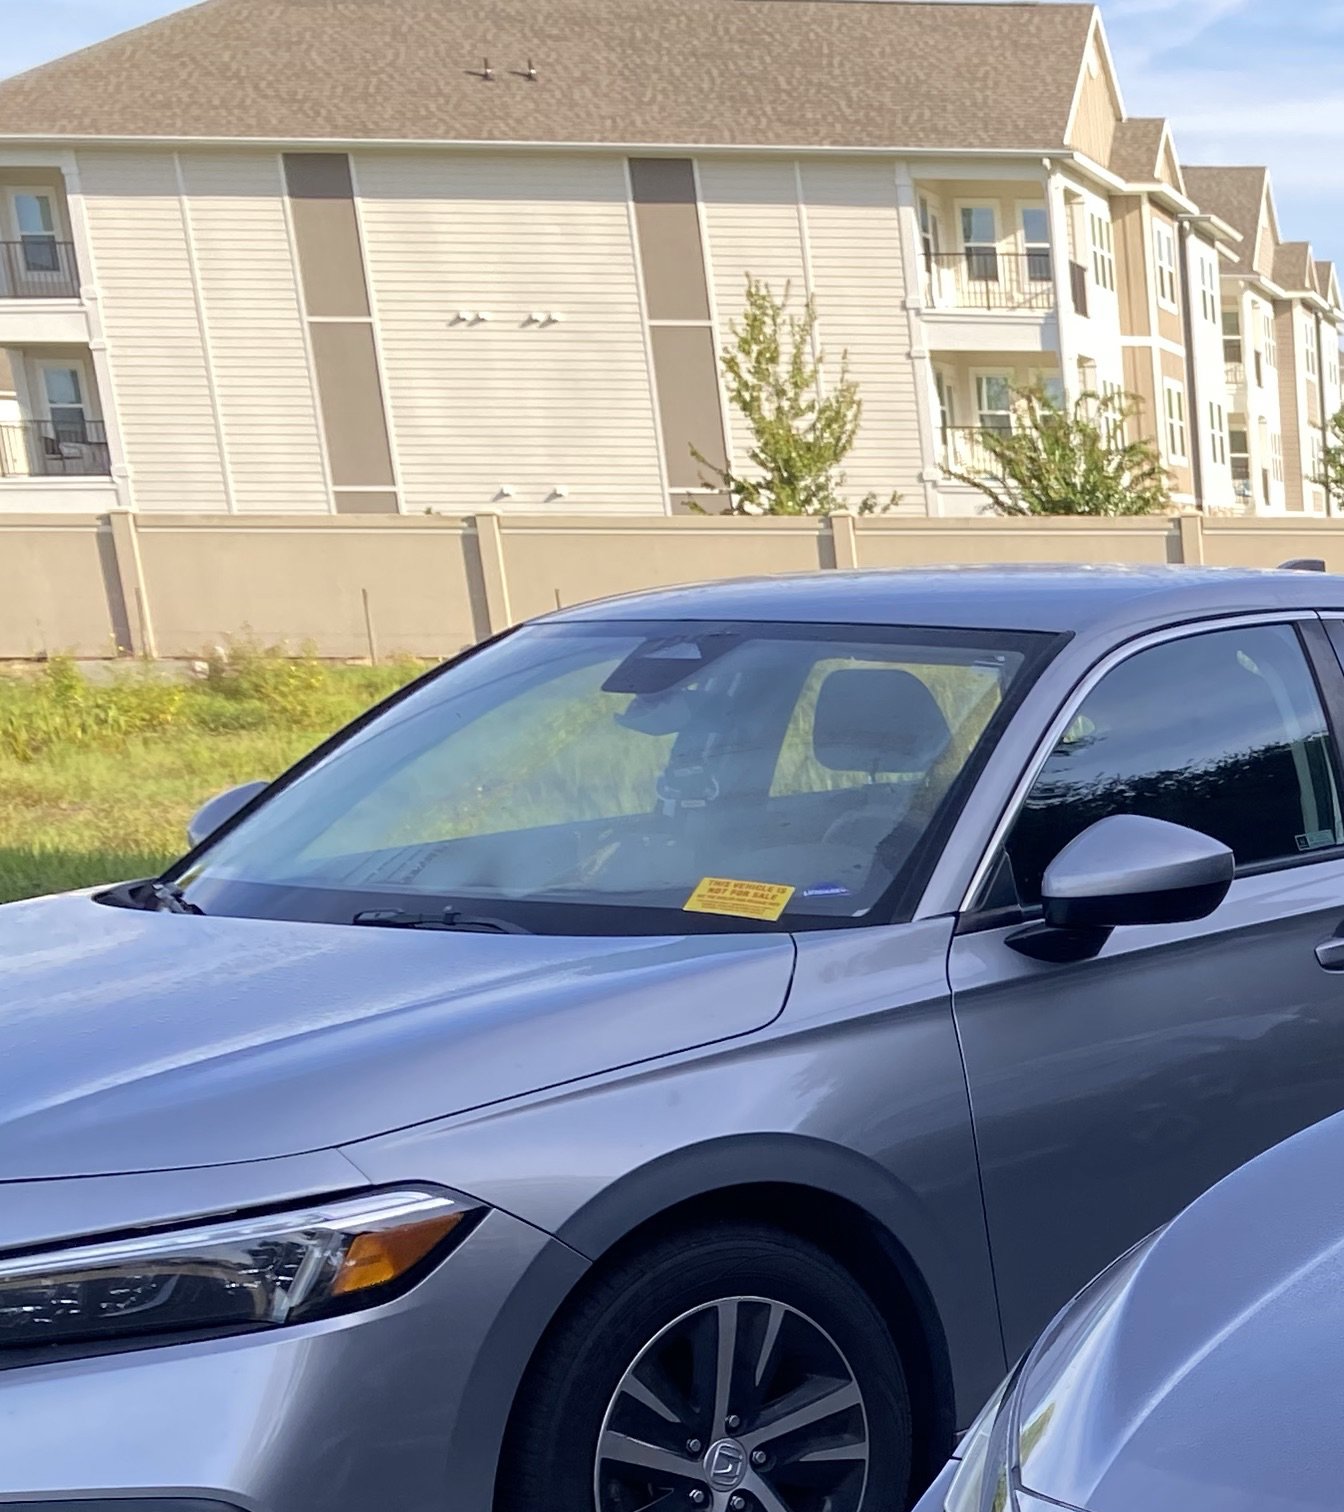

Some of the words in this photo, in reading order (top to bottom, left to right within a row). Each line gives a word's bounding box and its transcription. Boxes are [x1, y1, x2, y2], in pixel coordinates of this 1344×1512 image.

[733, 882, 774, 893] VEHICLE
[730, 889, 750, 897] FOR
[752, 891, 778, 900] SALE
